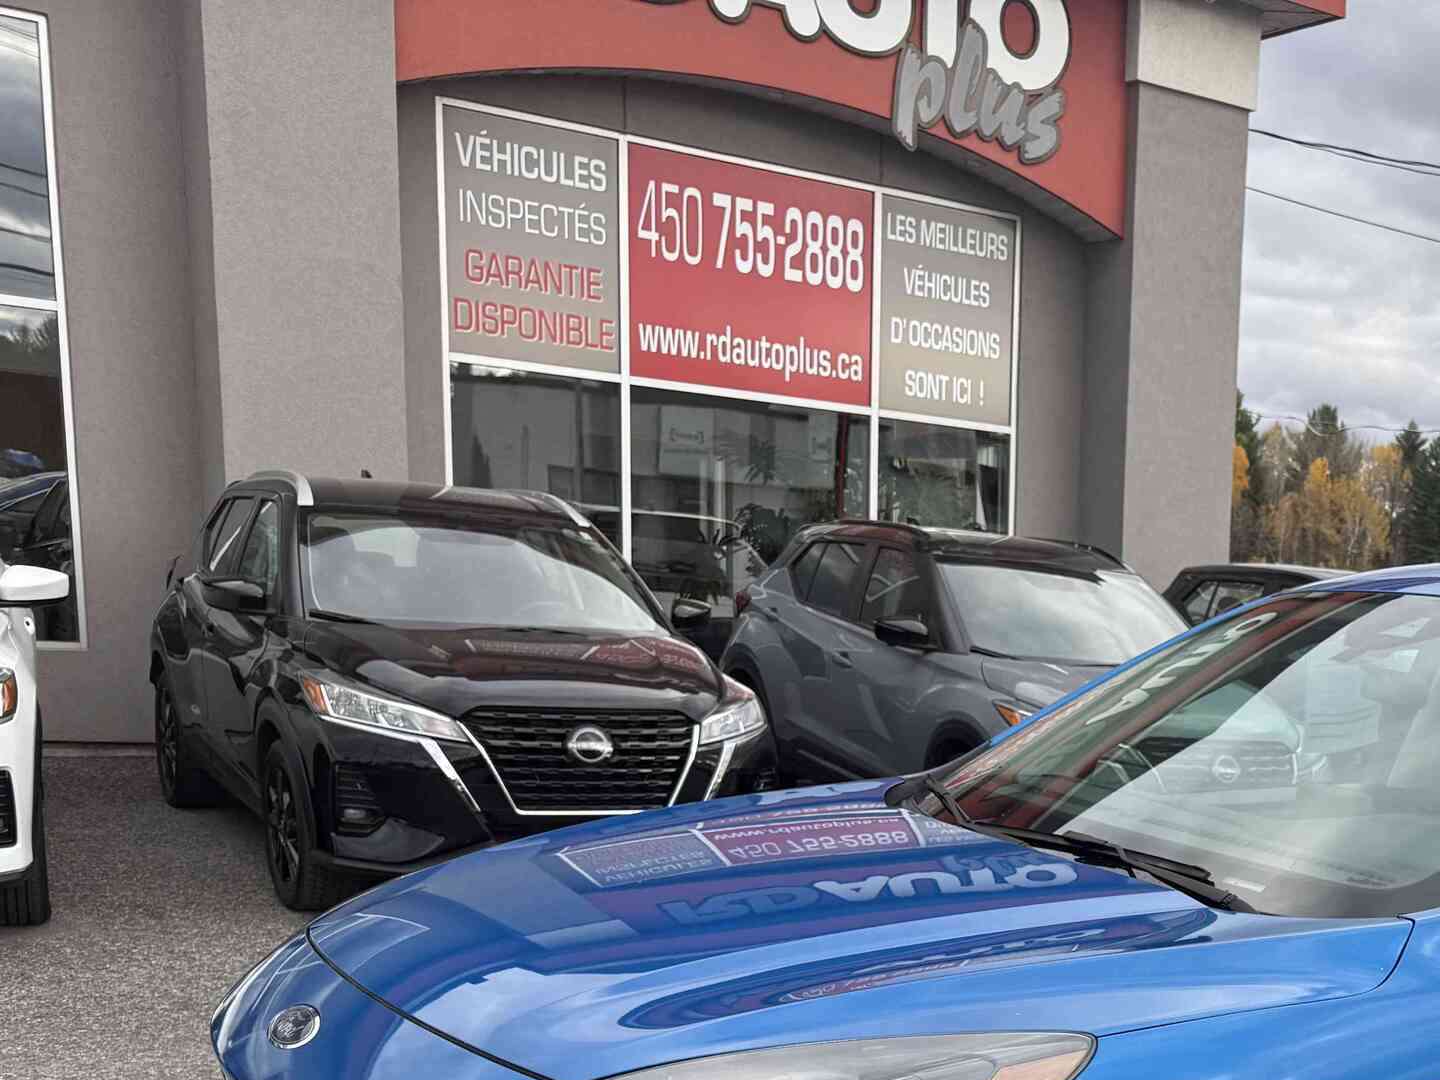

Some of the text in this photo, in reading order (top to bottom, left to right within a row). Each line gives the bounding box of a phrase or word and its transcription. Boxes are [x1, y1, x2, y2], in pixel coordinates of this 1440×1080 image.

[891, 16, 1064, 165] plus
[454, 130, 607, 192] VÉHICULES
[457, 188, 607, 245] INSPECTÉS
[637, 179, 864, 292] 450 755-2888
[887, 212, 1008, 261] LES MEILLEURS
[465, 249, 604, 302] GARANTIE
[903, 264, 990, 308] VÉHICULES
[453, 297, 616, 352] DISPONIBLE
[638, 322, 863, 382] www.rdautoplus.ca
[904, 370, 949, 401] SONT
[952, 376, 971, 405] ICI
